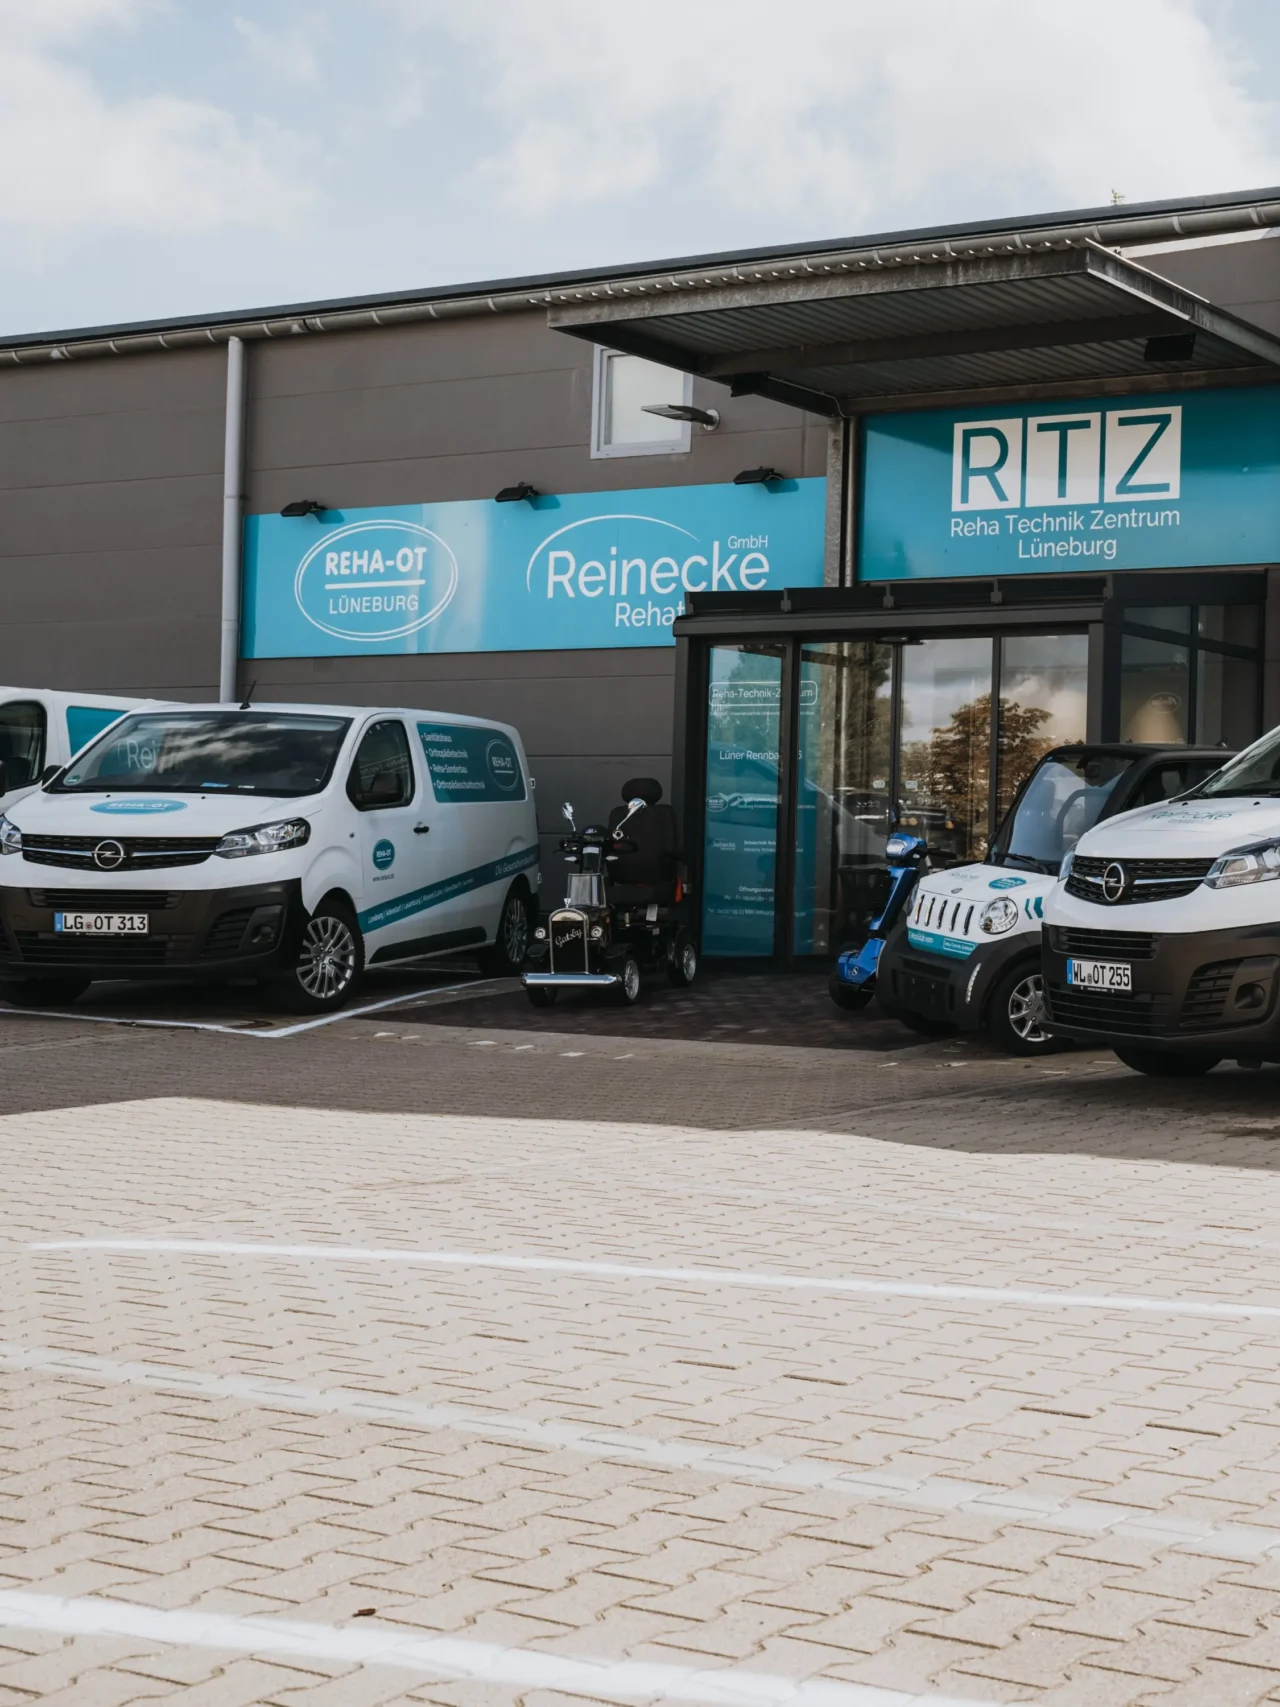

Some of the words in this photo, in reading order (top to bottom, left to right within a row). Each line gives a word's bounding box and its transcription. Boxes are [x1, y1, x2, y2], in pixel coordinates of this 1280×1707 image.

[960, 412, 1173, 504] RTZ
[951, 516, 1000, 537] Reha
[1005, 510, 1085, 534] Technik
[1090, 508, 1180, 530] Zentrum
[727, 535, 769, 550] GmbH
[1018, 536, 1117, 560] Lüneburg
[325, 547, 427, 576] REHA-OT
[547, 540, 771, 599] Reinecke
[328, 594, 420, 616] LÜNEBURG
[615, 600, 686, 628] Rehat
[720, 751, 744, 760] Lüner
[746, 750, 780, 760] Rennba
[64, 915, 83, 930] LG
[94, 916, 113, 930] OT
[118, 916, 146, 931] 313
[555, 929, 583, 947] Gatsby
[1073, 963, 1086, 982] WL
[1093, 965, 1106, 984] OT
[1109, 967, 1129, 987] 255
